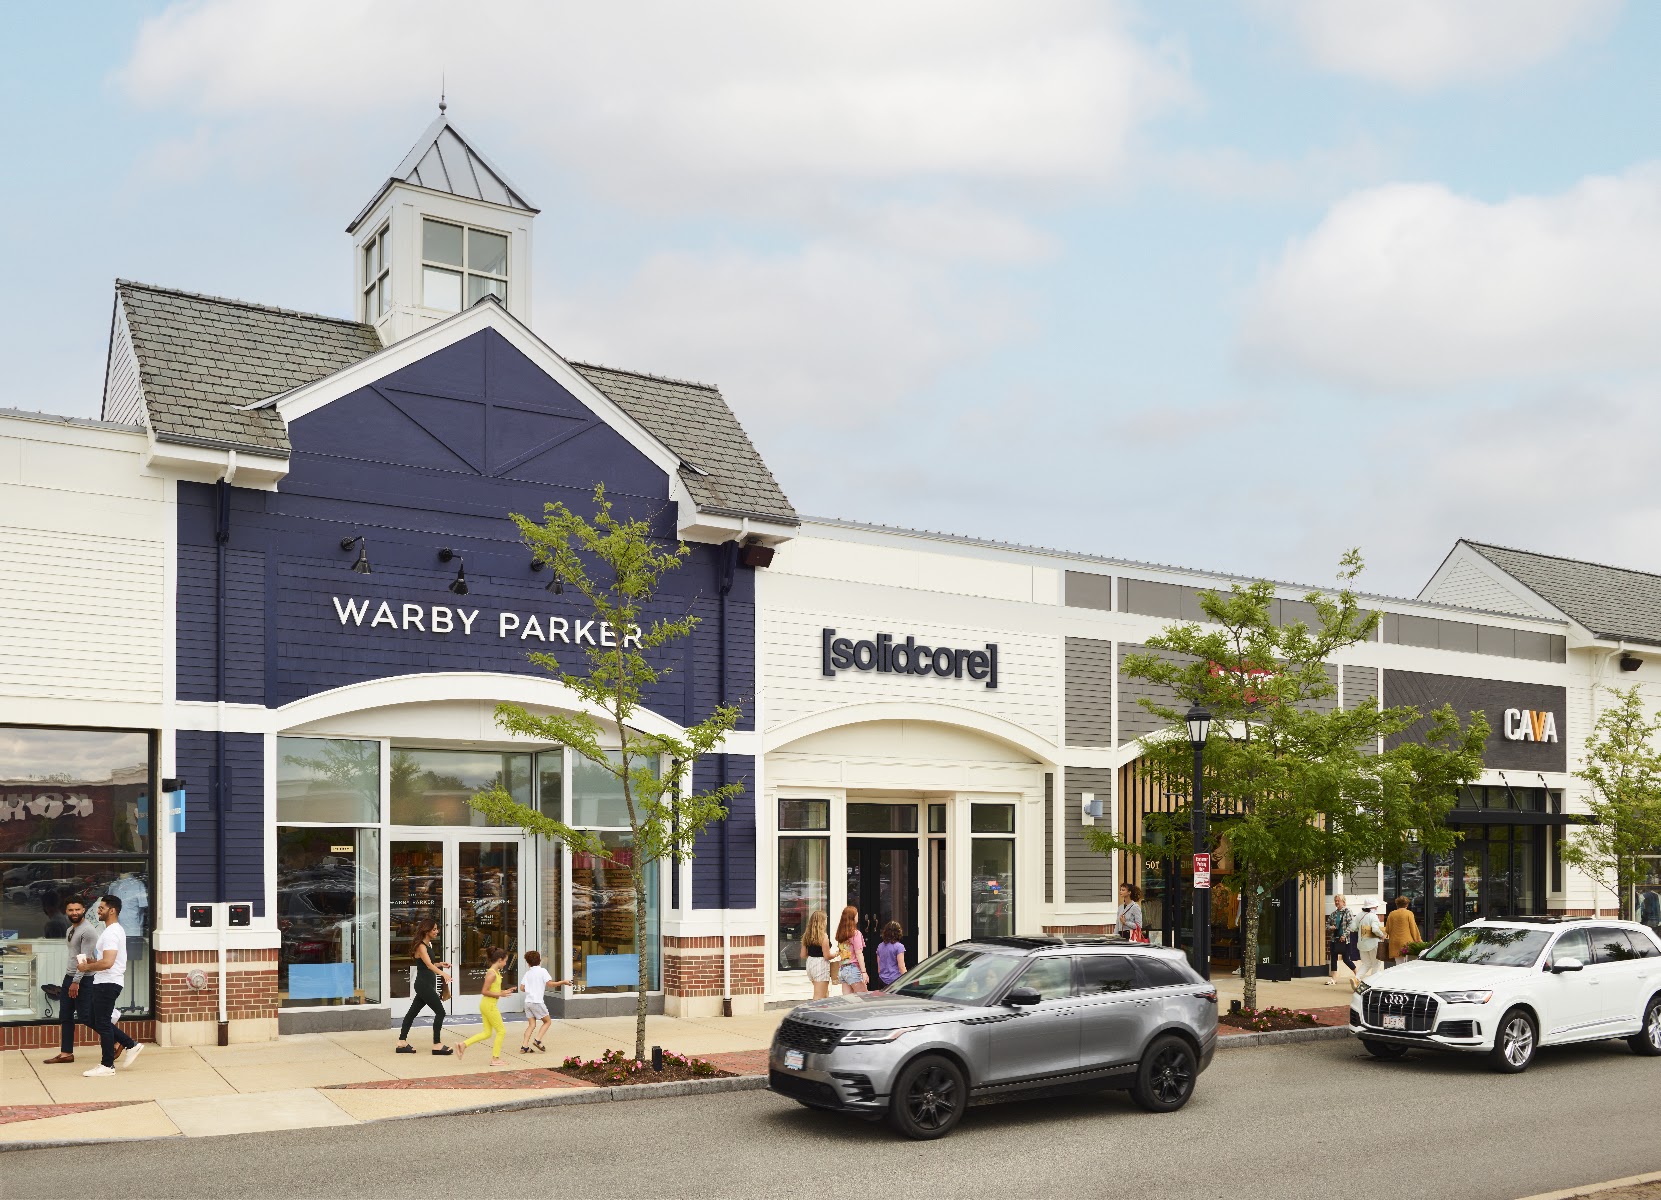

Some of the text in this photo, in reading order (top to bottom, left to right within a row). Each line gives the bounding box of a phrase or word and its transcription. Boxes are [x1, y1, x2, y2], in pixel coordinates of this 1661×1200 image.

[332, 596, 644, 650] WARBY PARKER
[1504, 708, 1559, 743] CAVA
